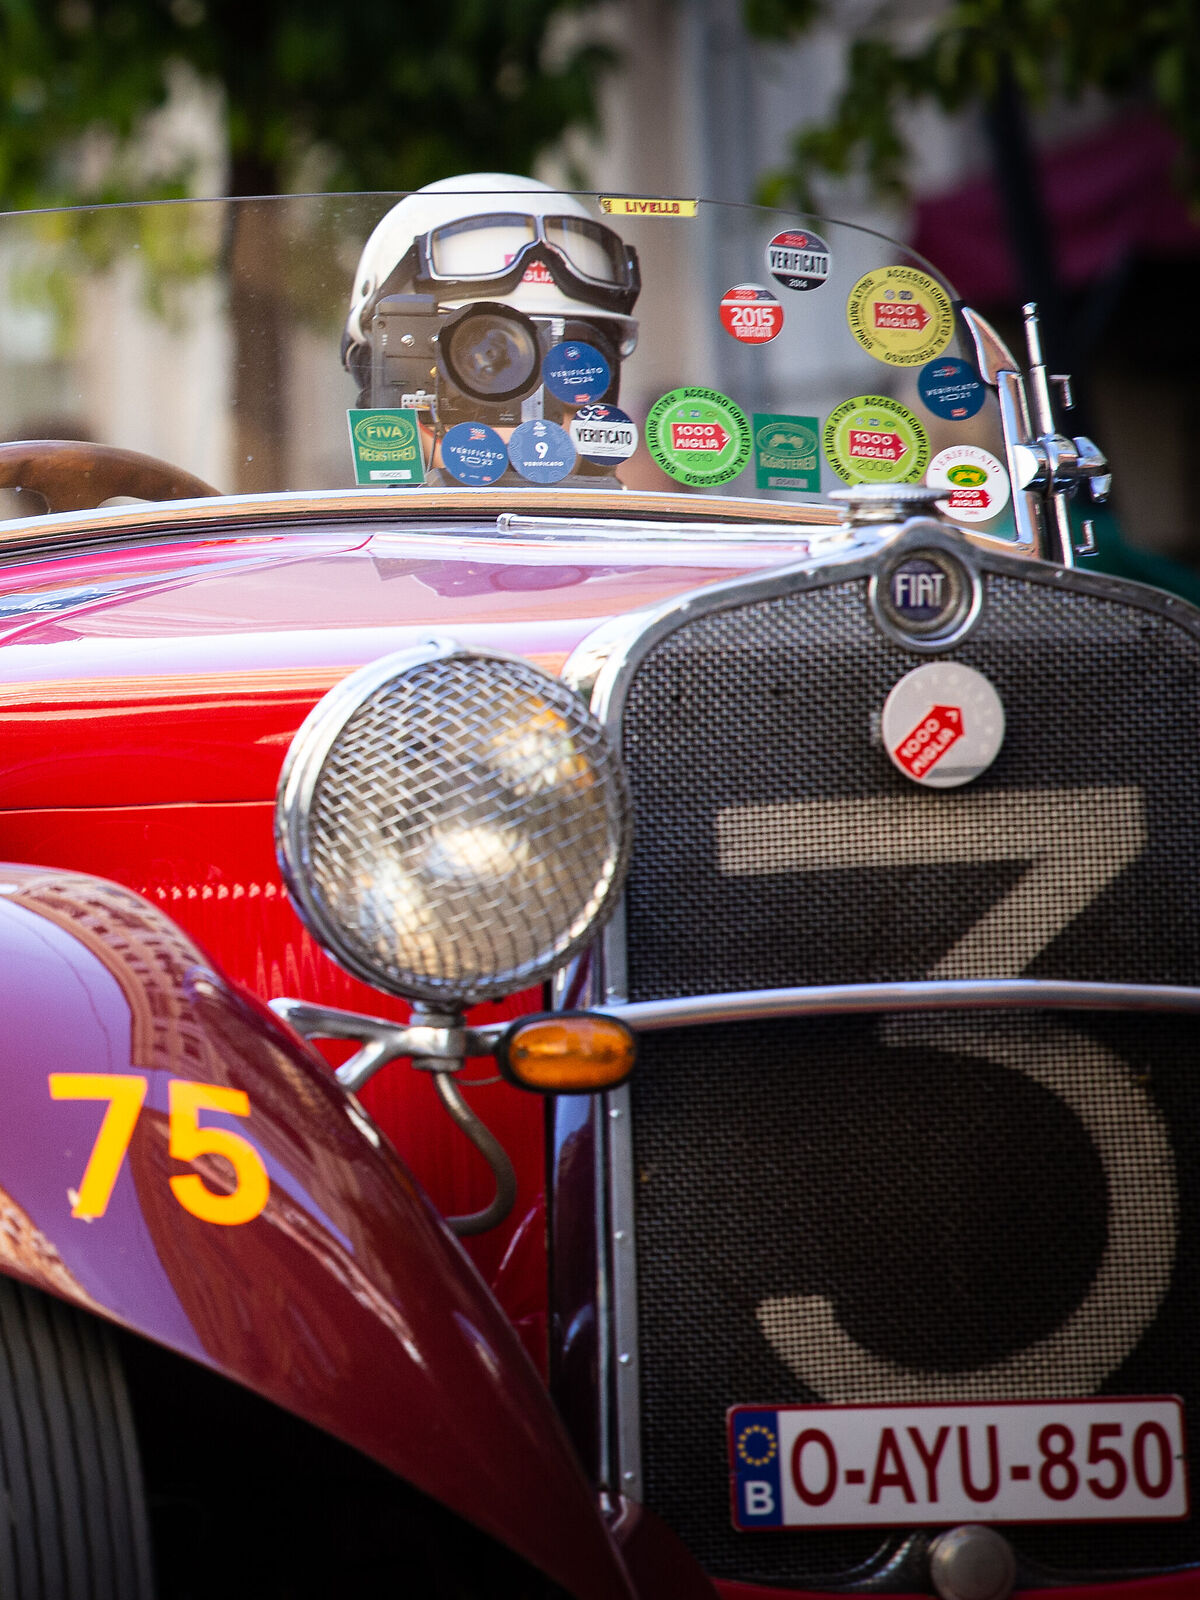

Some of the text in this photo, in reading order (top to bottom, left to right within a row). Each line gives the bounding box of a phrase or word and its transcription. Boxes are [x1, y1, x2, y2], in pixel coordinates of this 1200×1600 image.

[770, 250, 828, 274] VERIFICATO
[878, 304, 917, 316] 1000
[886, 269, 931, 289] ACCESSO
[930, 287, 952, 337] COMPLETO
[730, 307, 775, 326] 2015
[876, 317, 921, 329] MIGLIA
[735, 327, 772, 337] VERIFICATO
[855, 329, 874, 350] PASS
[550, 367, 604, 378] VERIFICATO
[683, 388, 729, 408] ACCESSO
[926, 382, 979, 396] VERIFICATO
[366, 426, 404, 438] FIVA
[576, 428, 632, 445] VERIFICATO
[676, 425, 716, 437] 1000
[727, 406, 750, 457] COMPLETO
[825, 424, 836, 455] ROUTE
[854, 433, 894, 446] 1000
[863, 397, 909, 419] ACCESSO
[907, 417, 927, 468] COMPLETO
[535, 441, 549, 459] 9
[648, 420, 660, 449] ROUTE
[655, 452, 677, 474] PASS
[675, 438, 720, 449] MIGLIA
[850, 445, 896, 458] MIGLIA
[450, 446, 504, 460] VERIFICATO
[460, 455, 493, 466] 2022
[933, 449, 1001, 474] VERIFICATO
[830, 458, 850, 481] PASS
[856, 459, 893, 473] 2009
[685, 467, 737, 485] PERCORSO
[951, 499, 984, 507] MIGLIA
[952, 490, 980, 499] 1000
[896, 573, 945, 608] FIAT
[901, 718, 941, 758] 1000
[911, 727, 955, 774] MIGLIA
[47, 1072, 270, 1226] 75
[790, 1419, 1174, 1507] O-AYU-850
[744, 1480, 775, 1516] B
